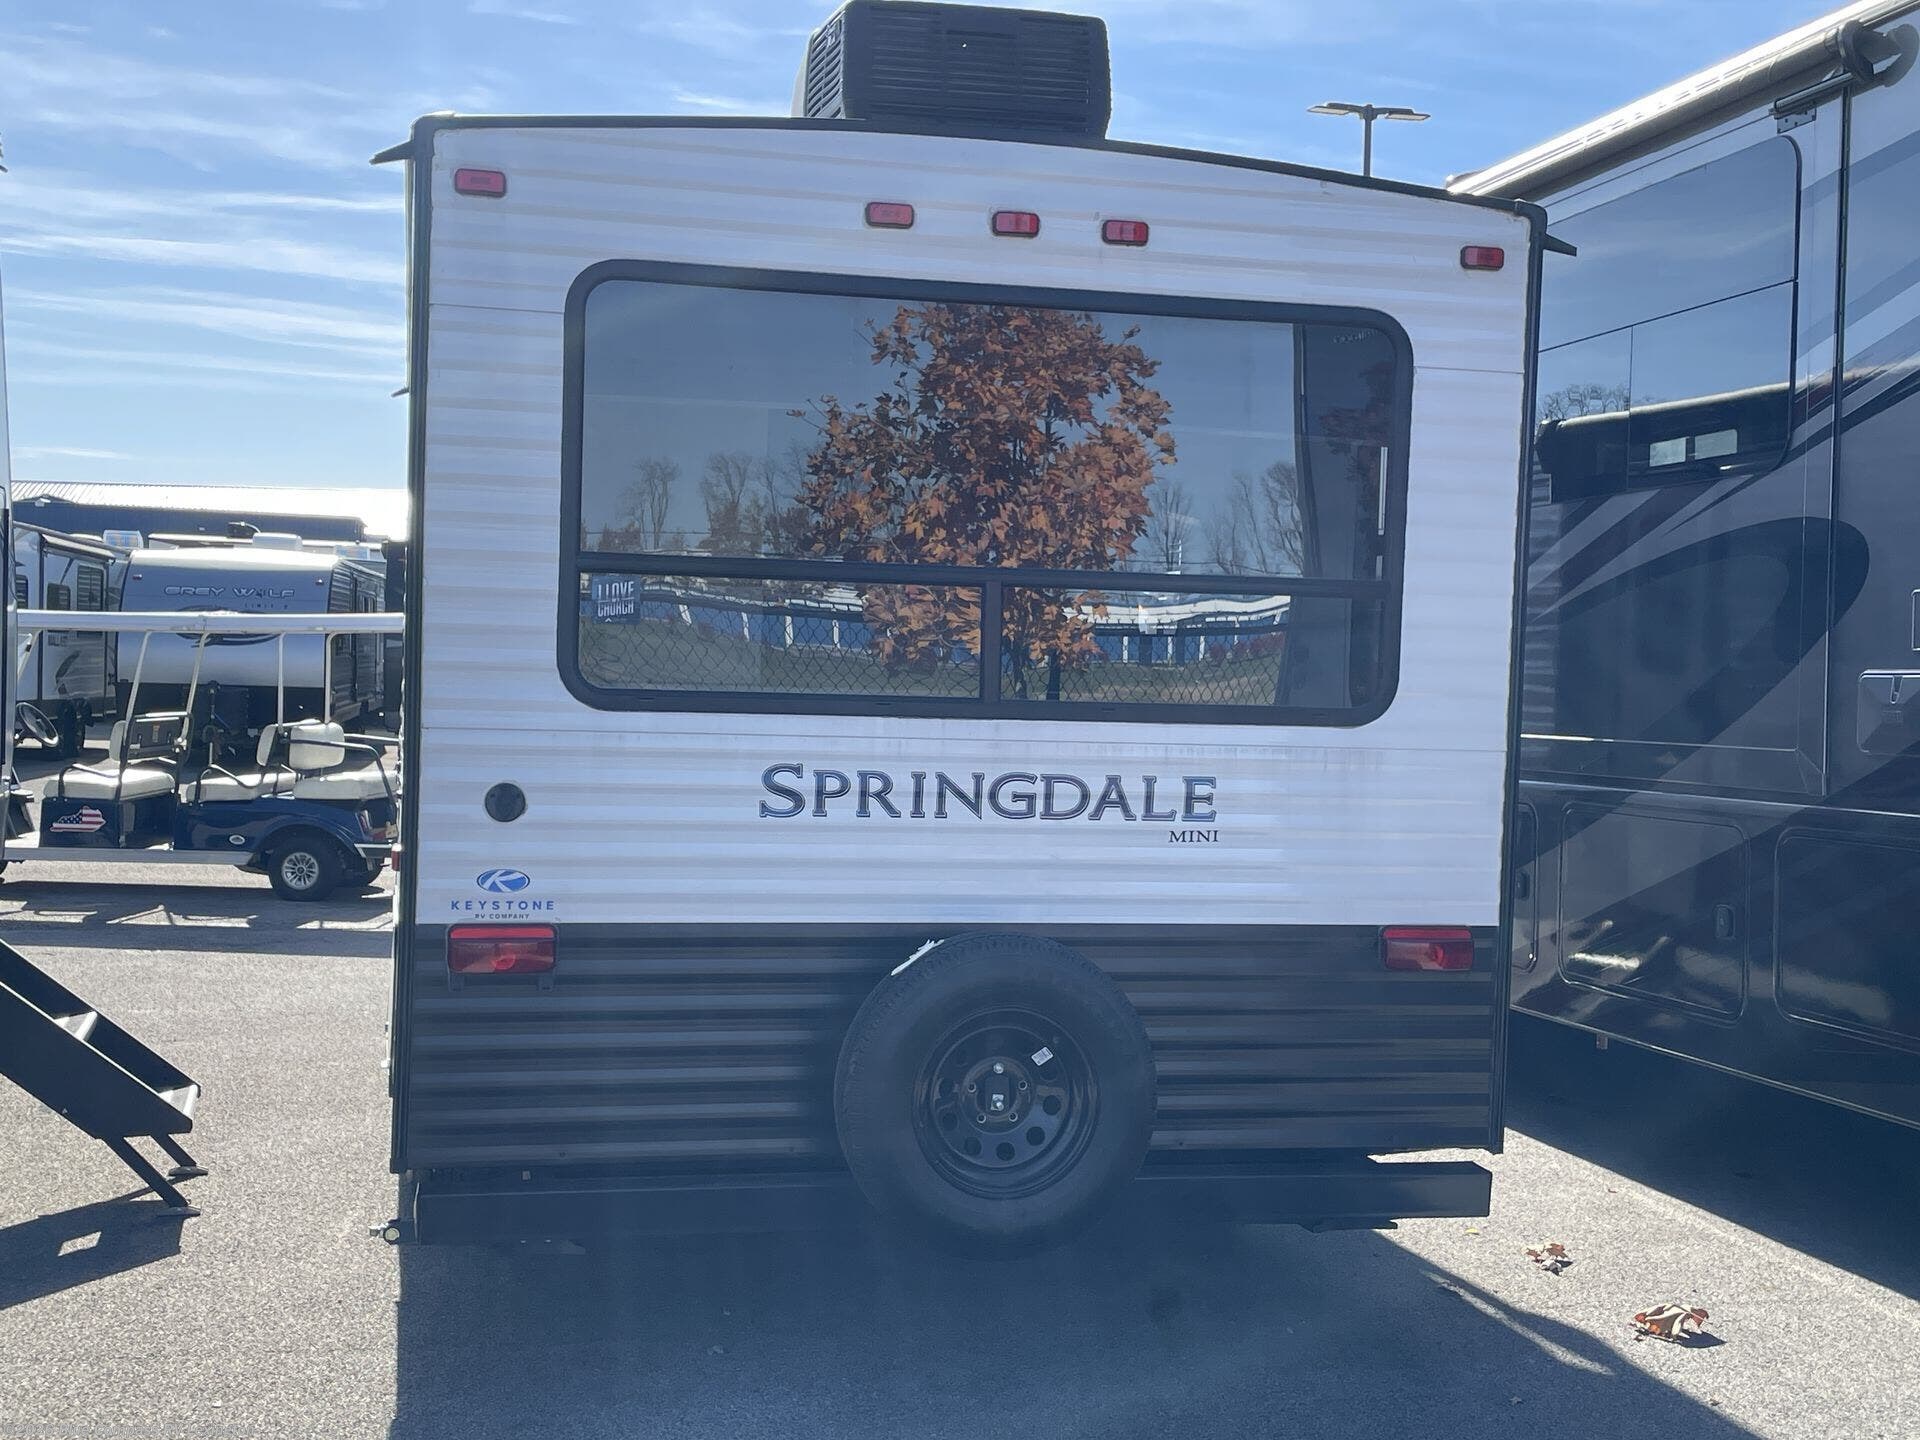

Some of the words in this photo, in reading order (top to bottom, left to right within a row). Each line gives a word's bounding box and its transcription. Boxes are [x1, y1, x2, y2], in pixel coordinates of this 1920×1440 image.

[759, 762, 1218, 823] SPRINGDALE
[1168, 830, 1219, 843] MINI
[450, 900, 555, 911] KEYSTONE
